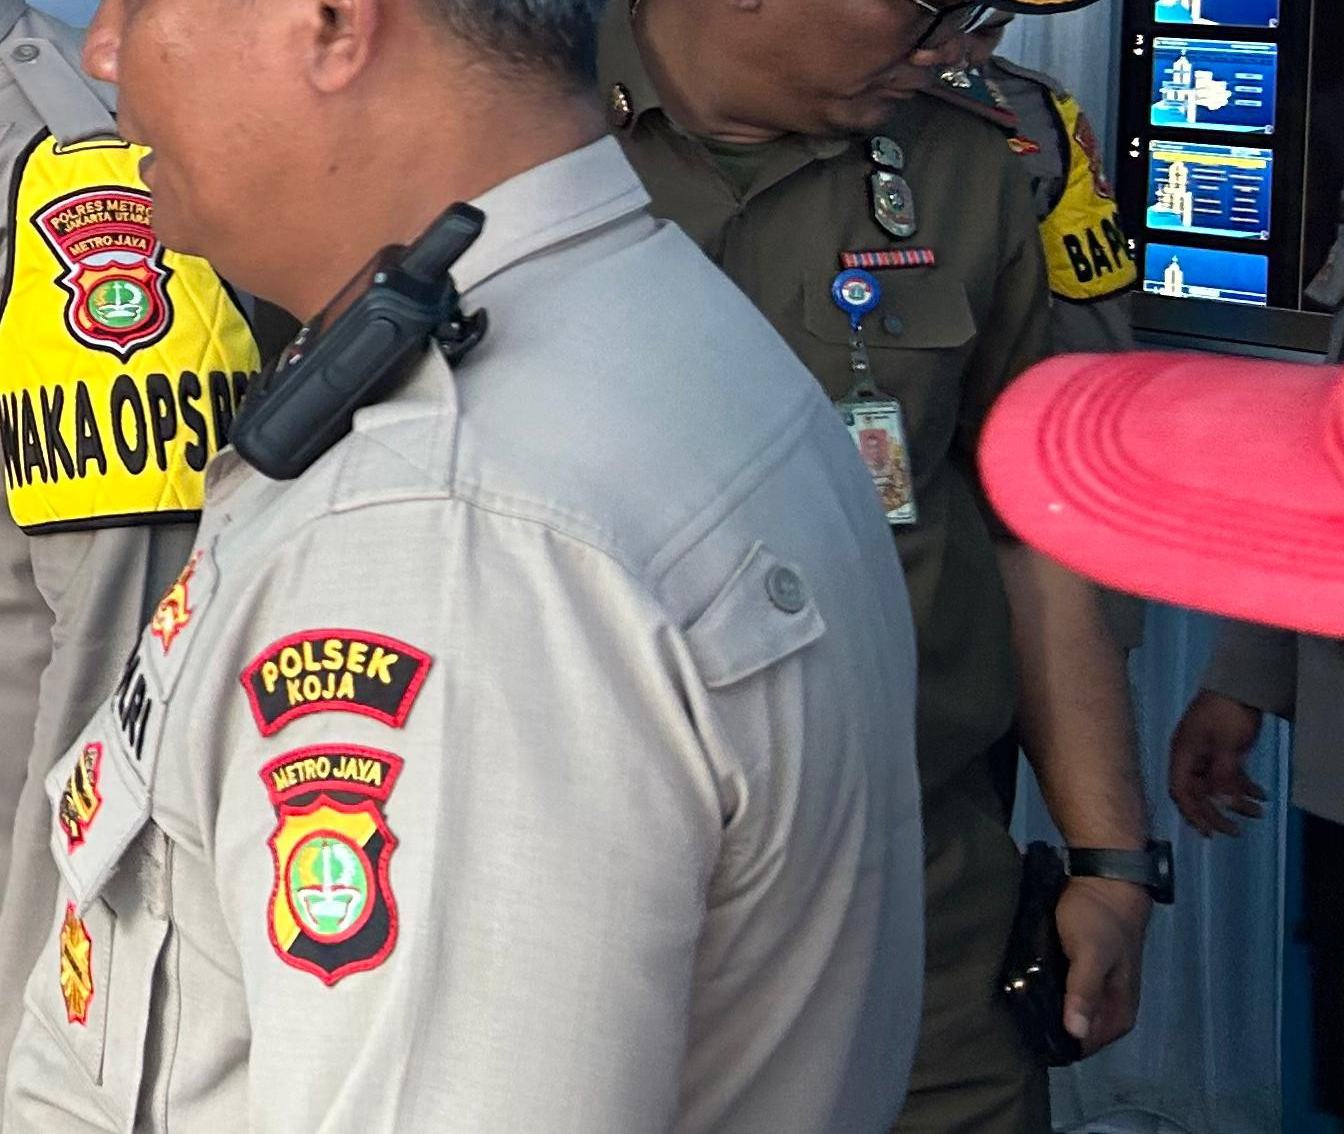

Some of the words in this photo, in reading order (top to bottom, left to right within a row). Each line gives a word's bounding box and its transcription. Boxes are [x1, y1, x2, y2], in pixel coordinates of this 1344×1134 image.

[1135, 34, 1144, 45] 3
[1130, 137, 1140, 148] 4
[50, 200, 104, 229] POLRES
[69, 235, 112, 256] METRO
[113, 234, 147, 250] JAYA
[111, 369, 209, 476] OPS
[261, 638, 399, 693] POLSEK
[287, 672, 355, 706] KOJA
[272, 757, 330, 792] METRO
[332, 758, 384, 786] JAYA
